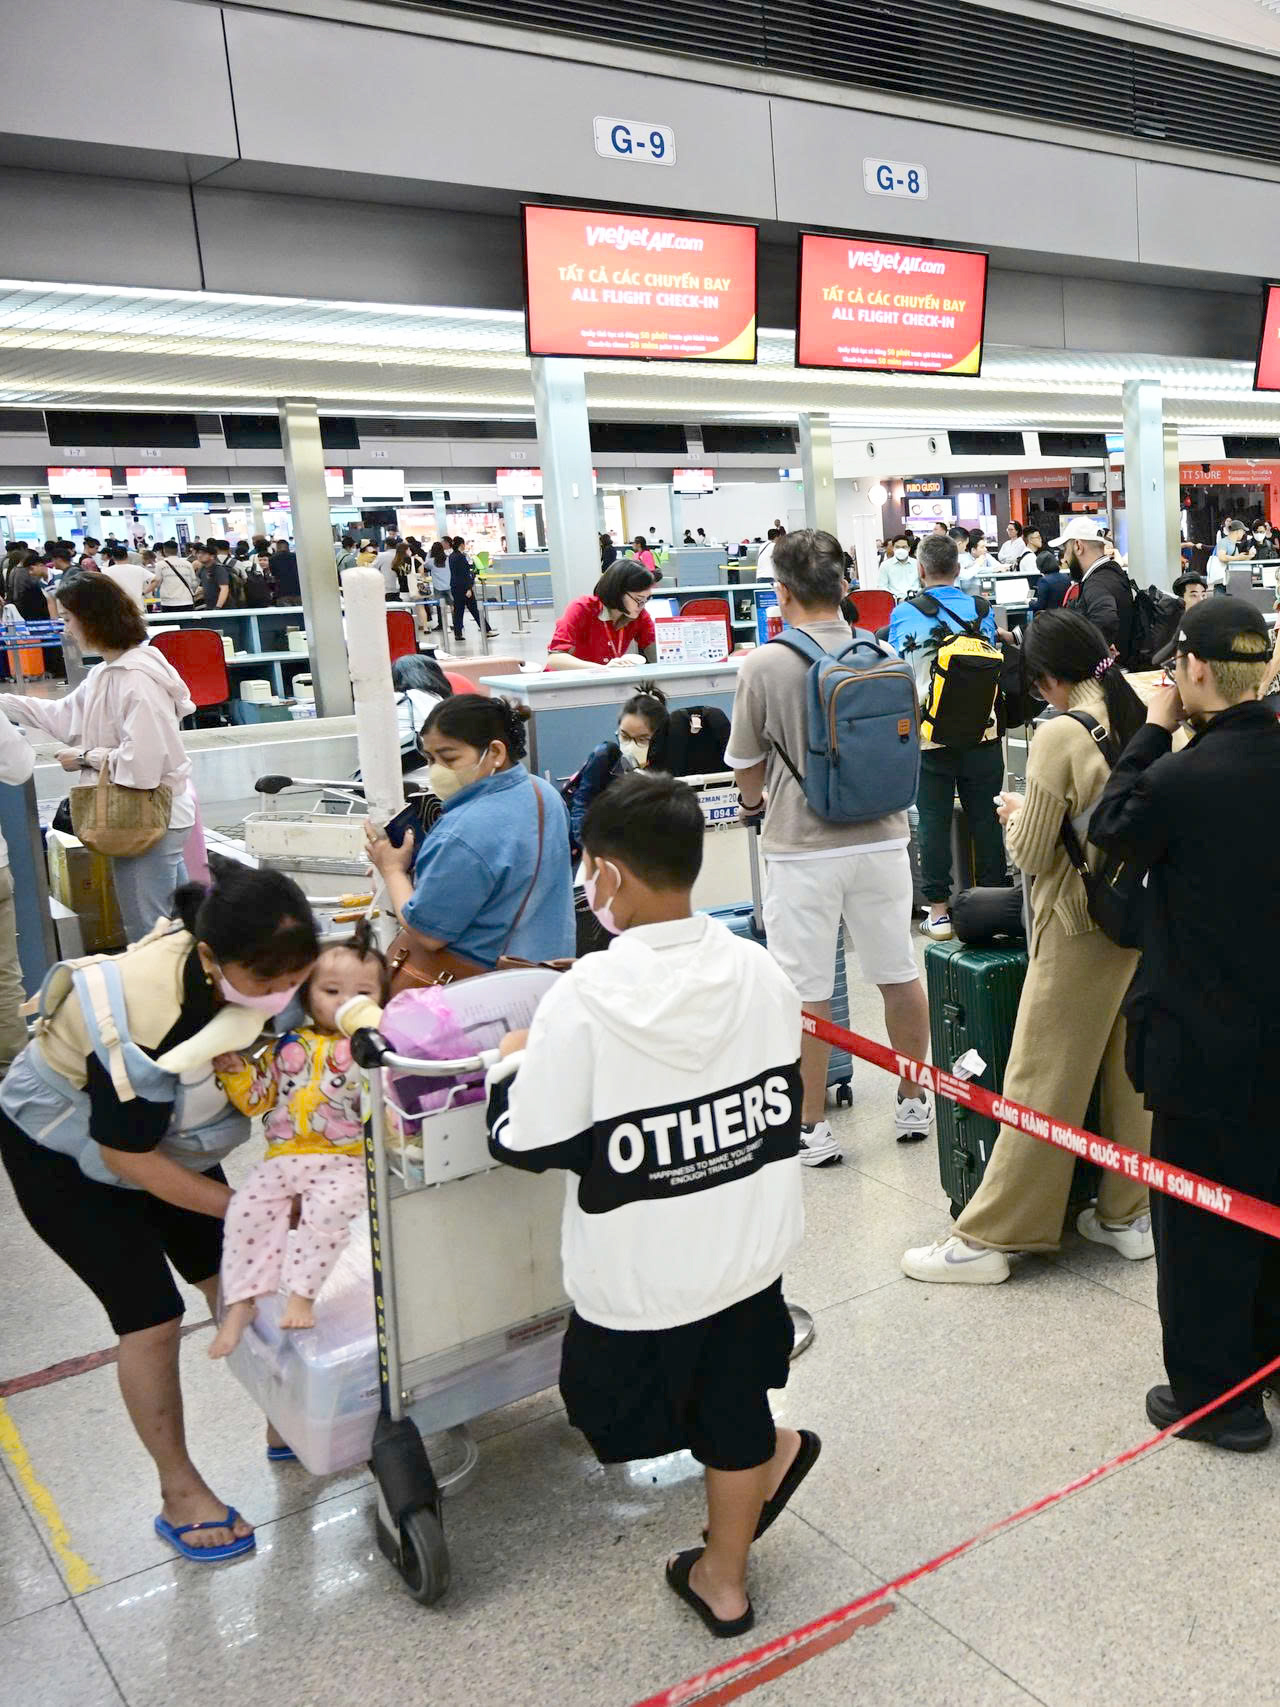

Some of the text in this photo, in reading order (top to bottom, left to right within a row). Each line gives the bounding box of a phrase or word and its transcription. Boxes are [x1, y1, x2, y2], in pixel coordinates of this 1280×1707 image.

[610, 124, 666, 159] G-9
[876, 164, 920, 194] G-8
[558, 263, 731, 291] TẤT CẢ CÁC CHUYẾN BAY
[572, 288, 719, 309] ALL FLIGHT CHECK-IN
[822, 285, 966, 312] TẤT CẢ CÁC CHUYẾN BAY
[832, 307, 955, 329] ALL FLIGHT CHECK-IN
[906, 482, 940, 493] PURO GUSTO
[1183, 471, 1221, 480] TT STORE
[697, 795, 720, 803] IZMAN
[895, 1055, 935, 1090] TIA
[608, 1075, 792, 1174] OTHERS
[649, 1163, 696, 1180] HAPPINESS
[697, 1160, 709, 1170] TO
[708, 1154, 730, 1167] MAKE
[730, 1148, 746, 1161] YOU
[992, 1099, 1232, 1214] CẢNG HÀNG KHÔNG QUỐC TẾ TÂN SƠN NHẤT
[670, 1169, 708, 1186] ENOUGH
[707, 1161, 735, 1176] TRIALS
